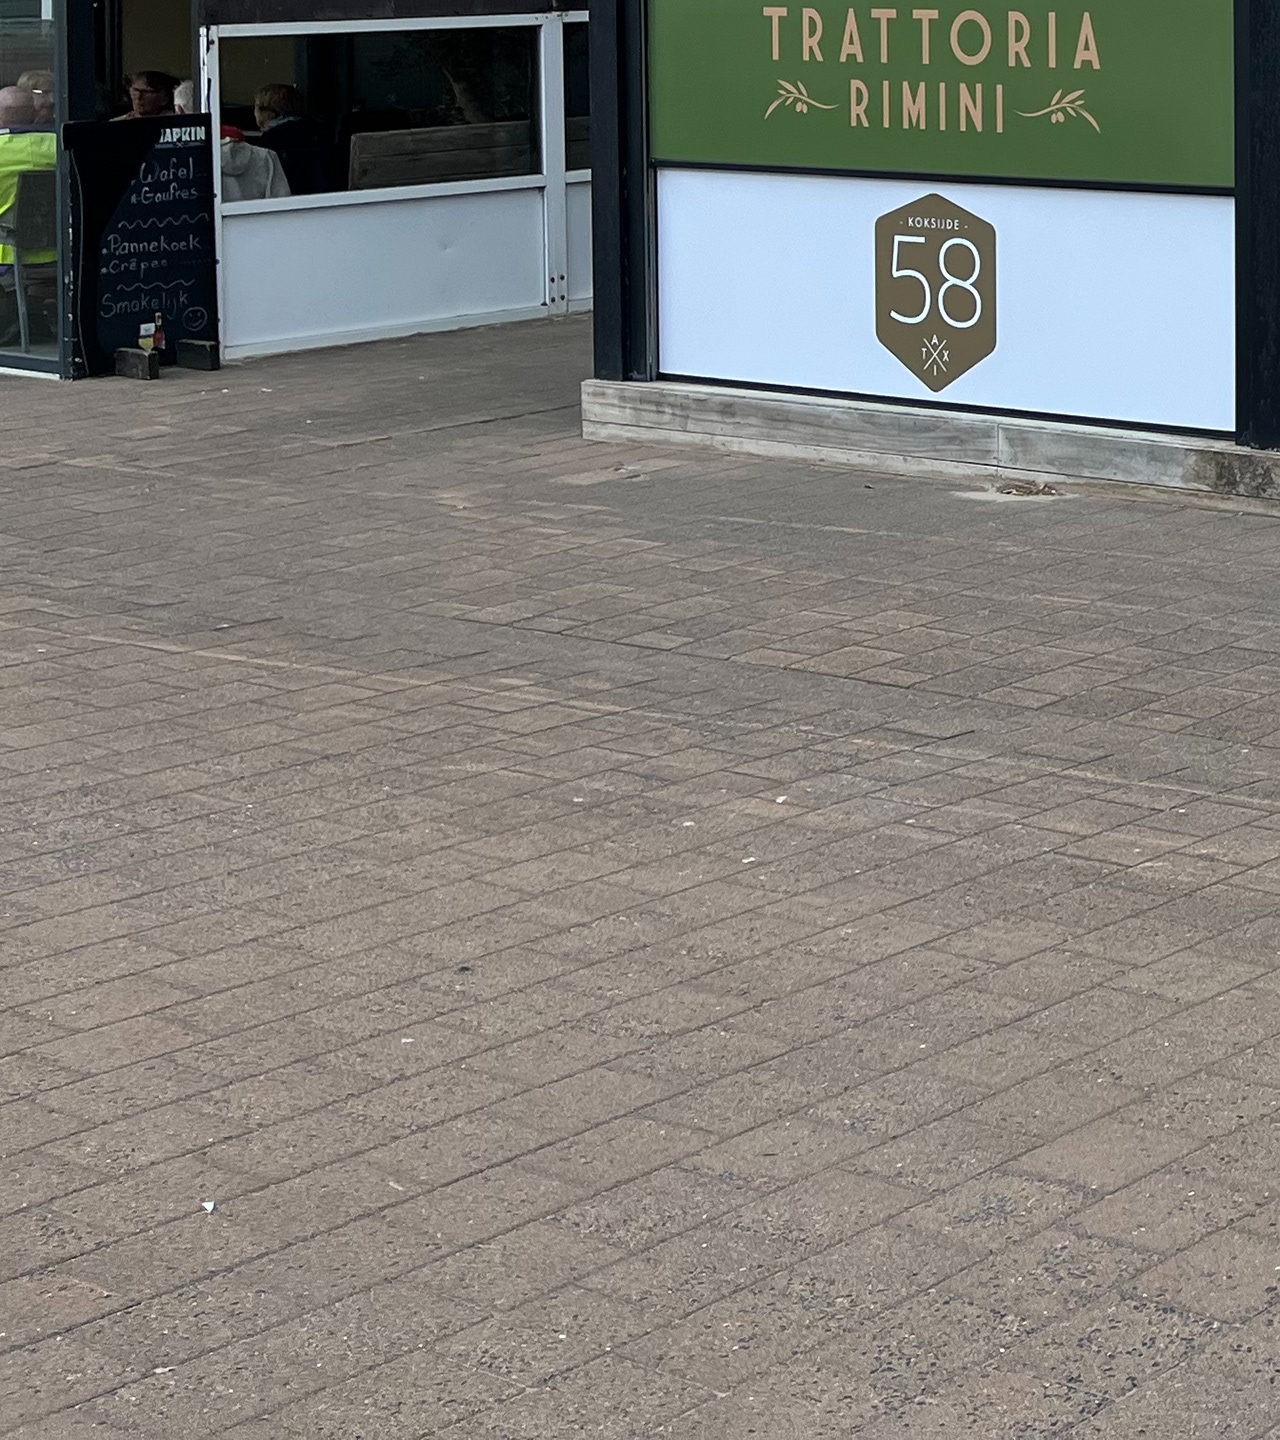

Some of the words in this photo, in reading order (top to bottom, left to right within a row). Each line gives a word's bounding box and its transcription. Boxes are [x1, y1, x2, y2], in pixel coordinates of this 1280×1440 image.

[763, 6, 1101, 70] TRATTORIA
[850, 78, 1004, 134] RIMINI
[140, 157, 194, 184] Wafel
[907, 216, 960, 231] KOKSIJDE
[107, 234, 201, 255] Pannekoek
[889, 234, 982, 329] 58
